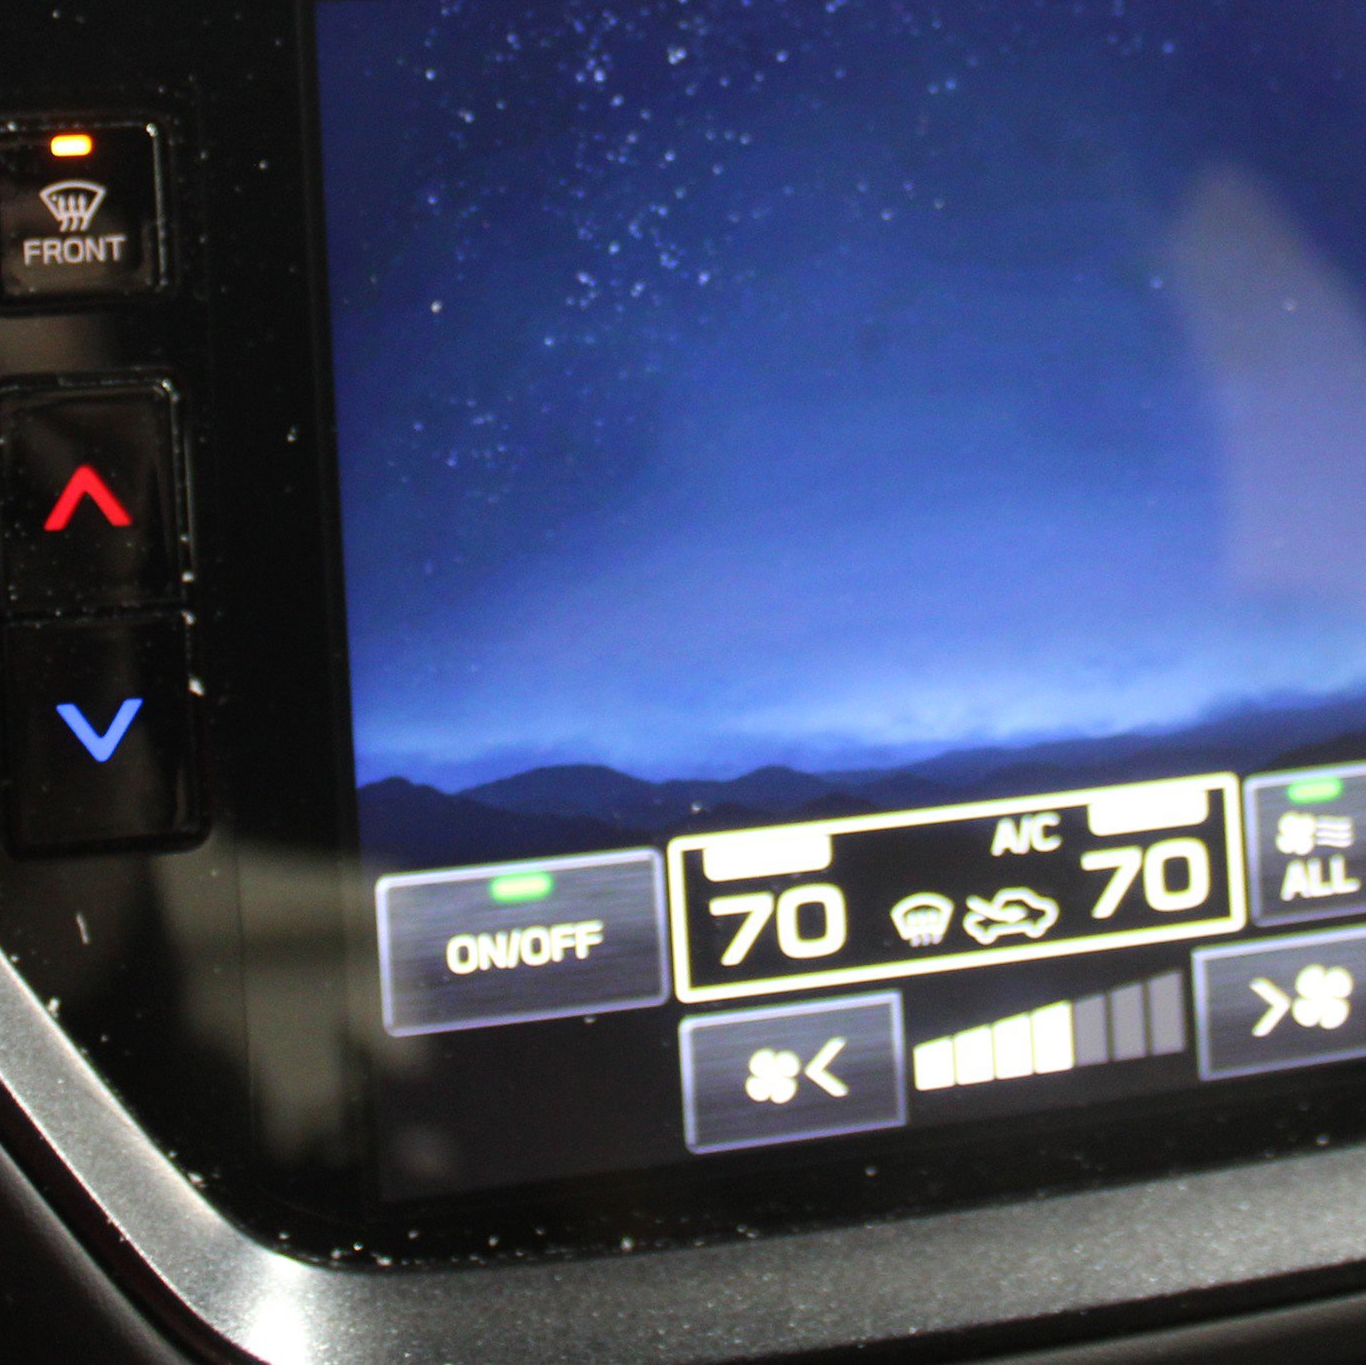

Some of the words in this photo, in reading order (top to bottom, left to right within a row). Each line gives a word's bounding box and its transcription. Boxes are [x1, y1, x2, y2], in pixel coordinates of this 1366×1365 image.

[23, 234, 127, 266] FRONT
[991, 812, 1062, 857] A/C
[1080, 838, 1211, 920] 70
[1280, 854, 1362, 901] ALL
[446, 920, 604, 976] ON/OFF
[708, 882, 848, 967] 70
